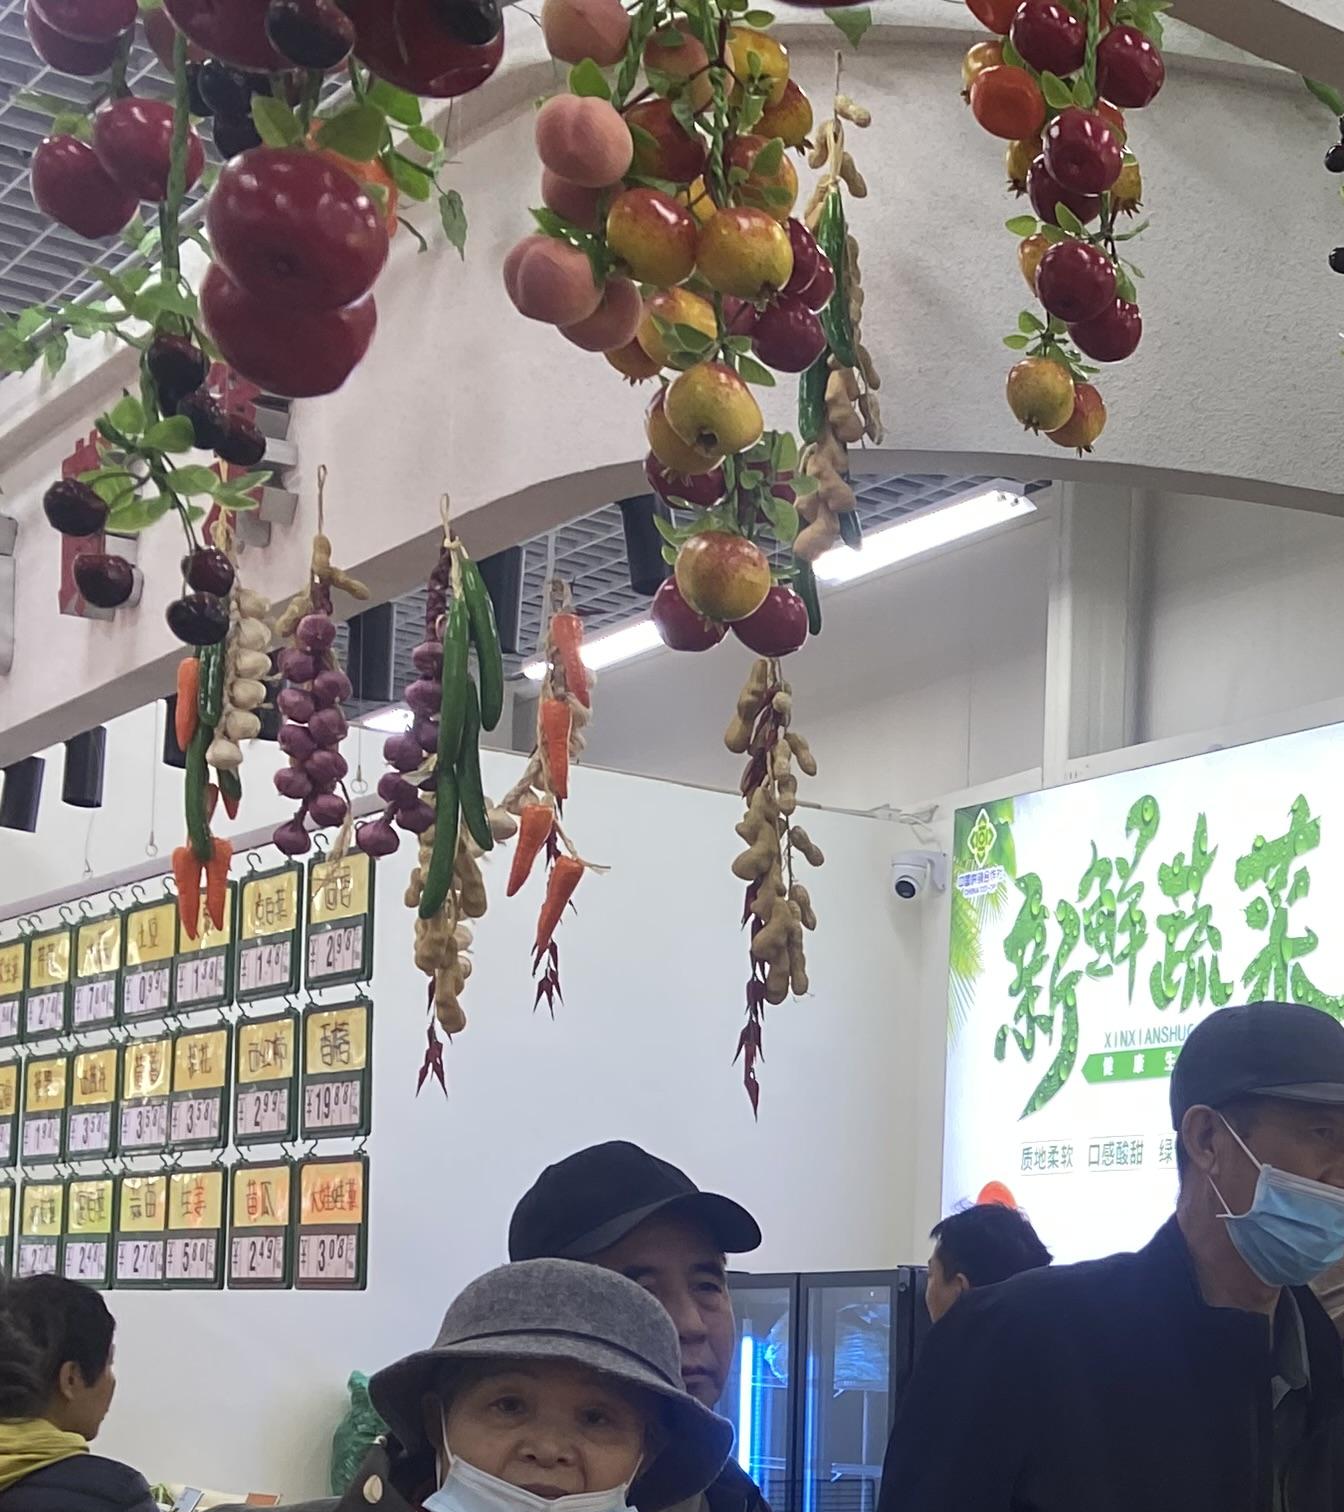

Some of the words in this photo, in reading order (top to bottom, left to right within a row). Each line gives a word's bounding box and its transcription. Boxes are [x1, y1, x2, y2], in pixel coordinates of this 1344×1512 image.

[1020, 1144, 1074, 1171] 质地柔软
[1088, 1139, 1144, 1167] 口感酸甜
